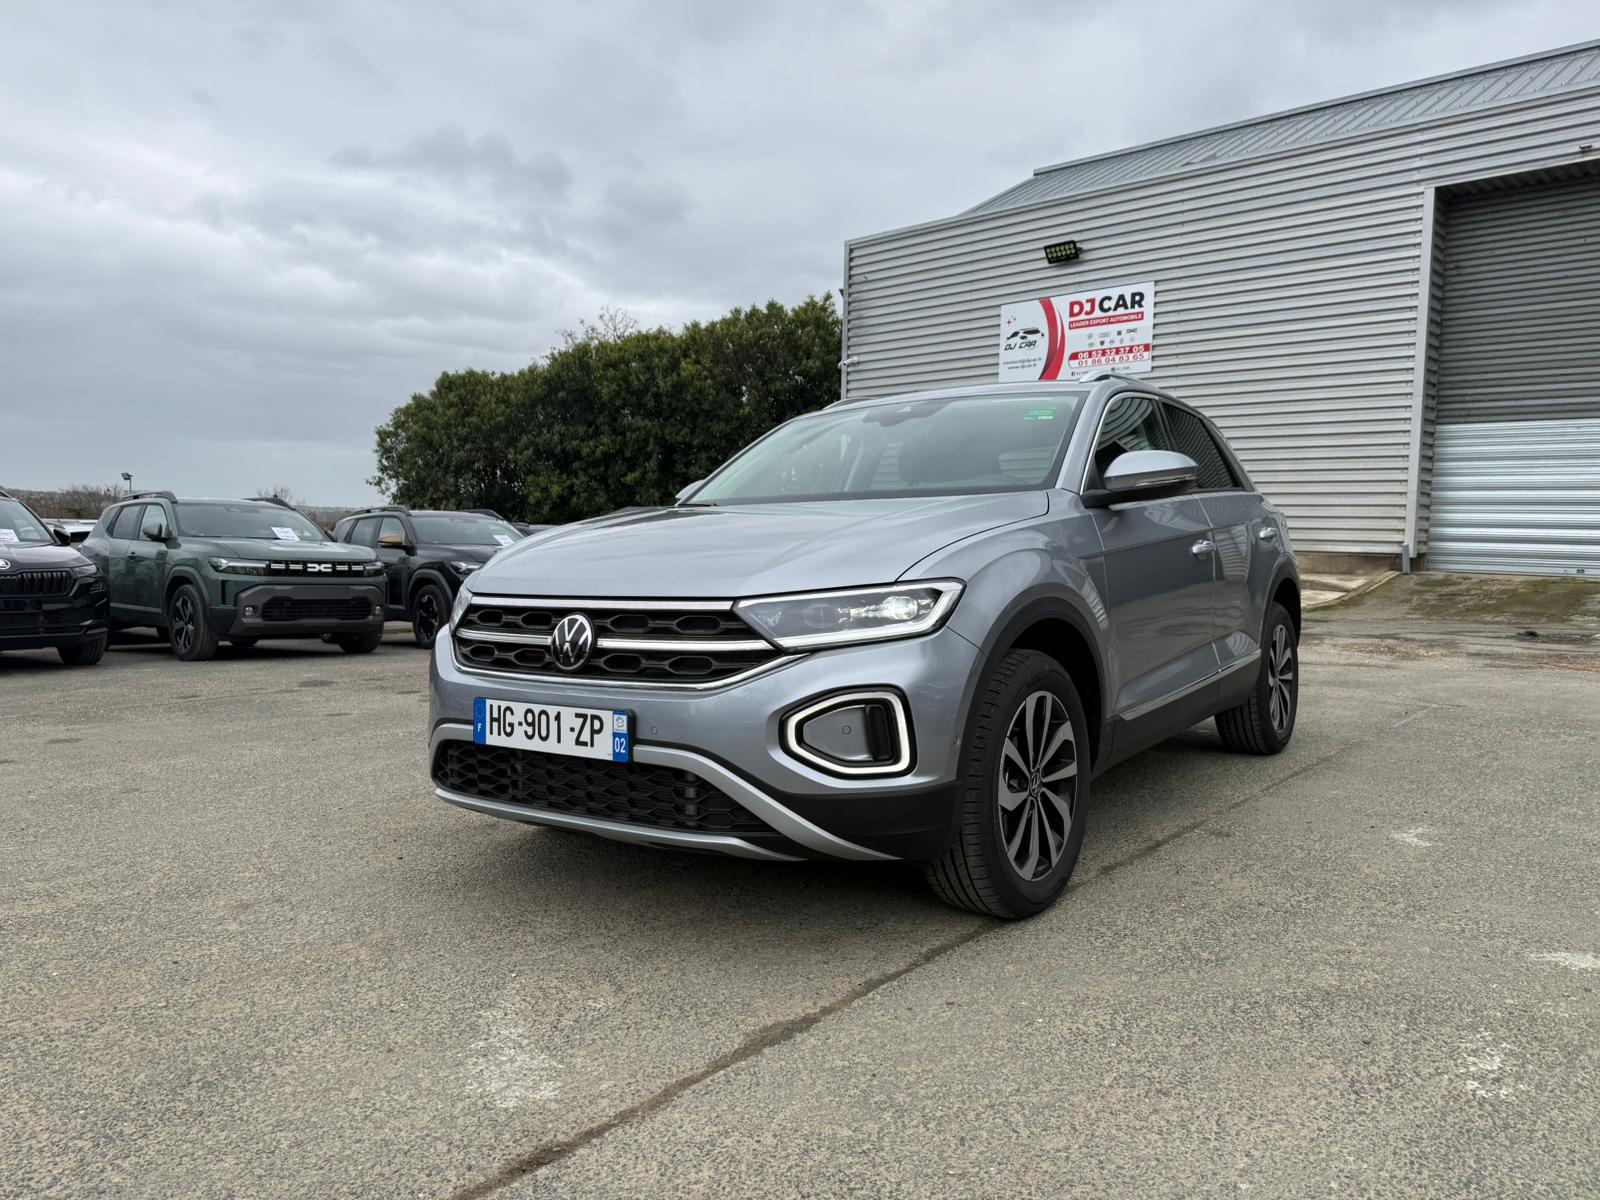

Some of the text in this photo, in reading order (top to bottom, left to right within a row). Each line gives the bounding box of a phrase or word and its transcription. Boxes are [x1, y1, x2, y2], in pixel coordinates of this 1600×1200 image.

[1069, 292, 1145, 318] DJ CAR
[1070, 320, 1089, 328] LEADER
[1110, 313, 1143, 323] AUTOMOBILE
[1004, 340, 1037, 351] DJ CAR
[478, 723, 482, 732] F
[489, 704, 604, 748] HG-901-ZP
[614, 738, 626, 753] 02
